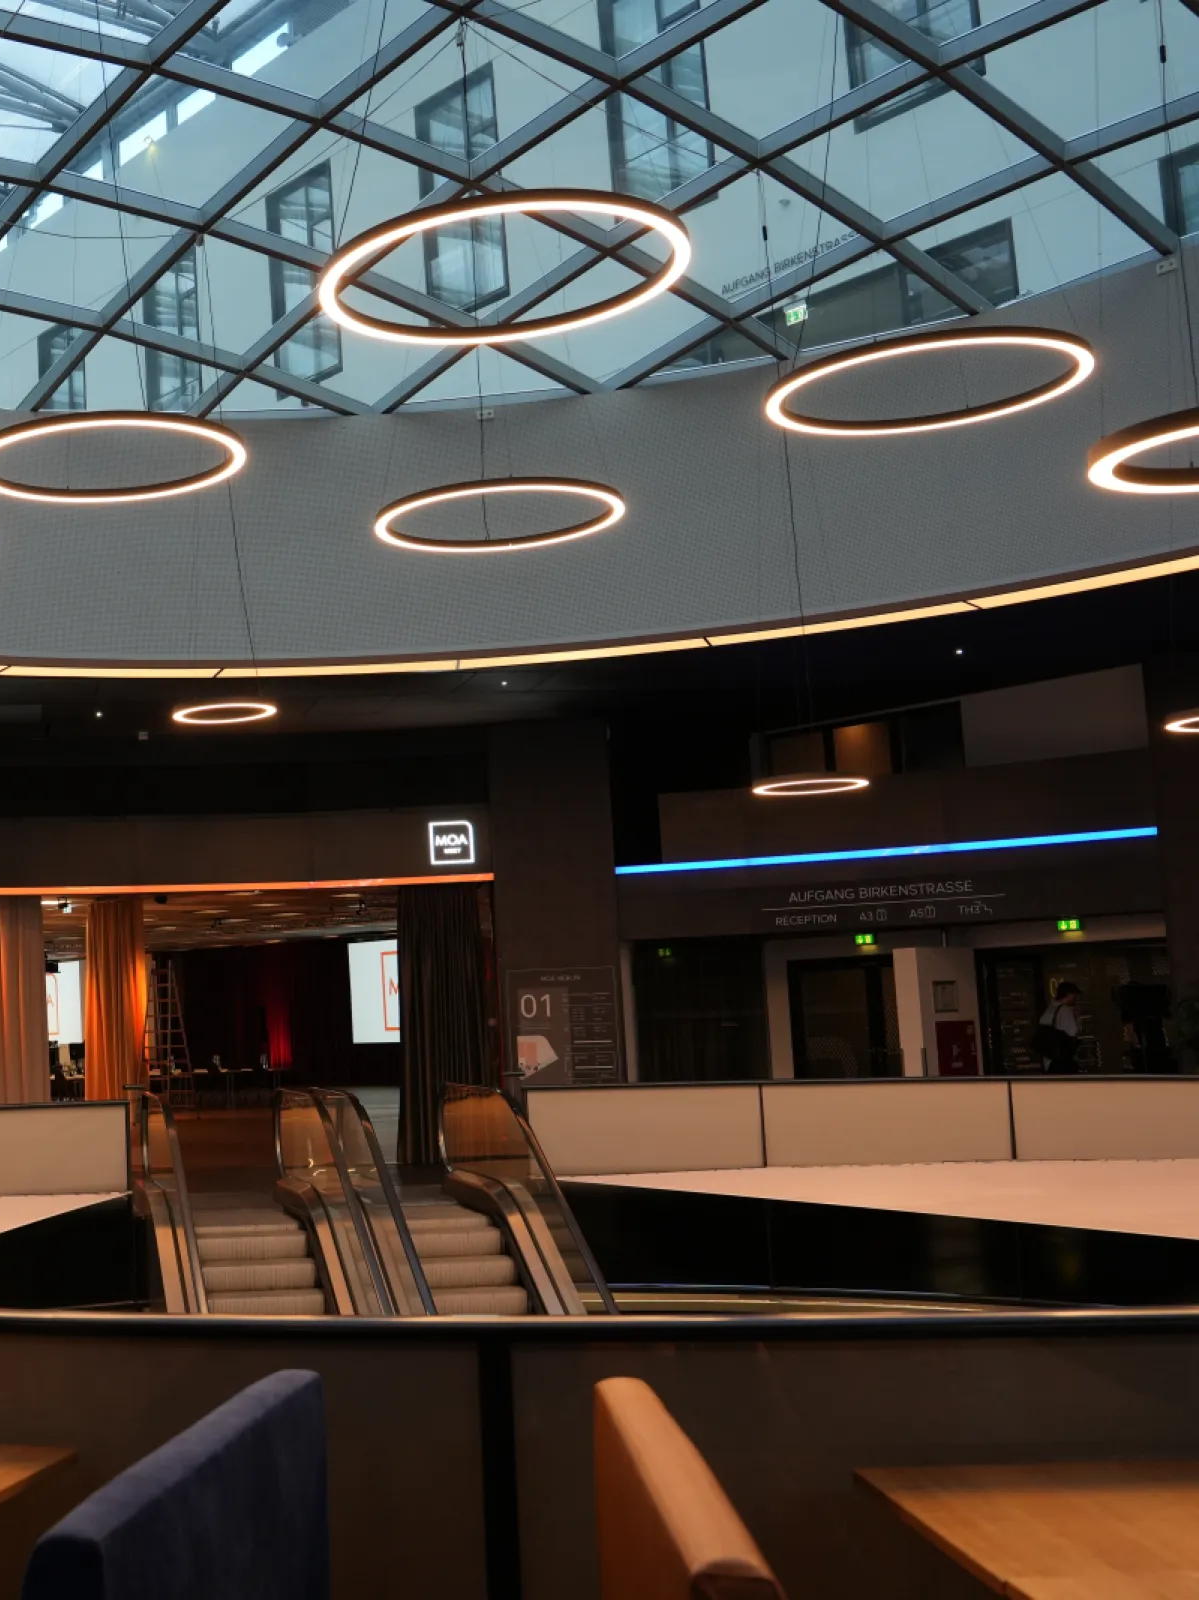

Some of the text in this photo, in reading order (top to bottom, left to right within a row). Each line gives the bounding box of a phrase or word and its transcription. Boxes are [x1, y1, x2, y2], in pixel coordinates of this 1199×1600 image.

[721, 230, 856, 294] AUFGANG BIRKENSTRASS
[435, 833, 469, 846] MOA
[788, 880, 974, 903] AUFGANG BIRKENSTRASSE
[775, 914, 837, 926] RECEPTION
[859, 911, 874, 921] A3
[909, 908, 924, 919] A5
[520, 993, 552, 1019] 01
